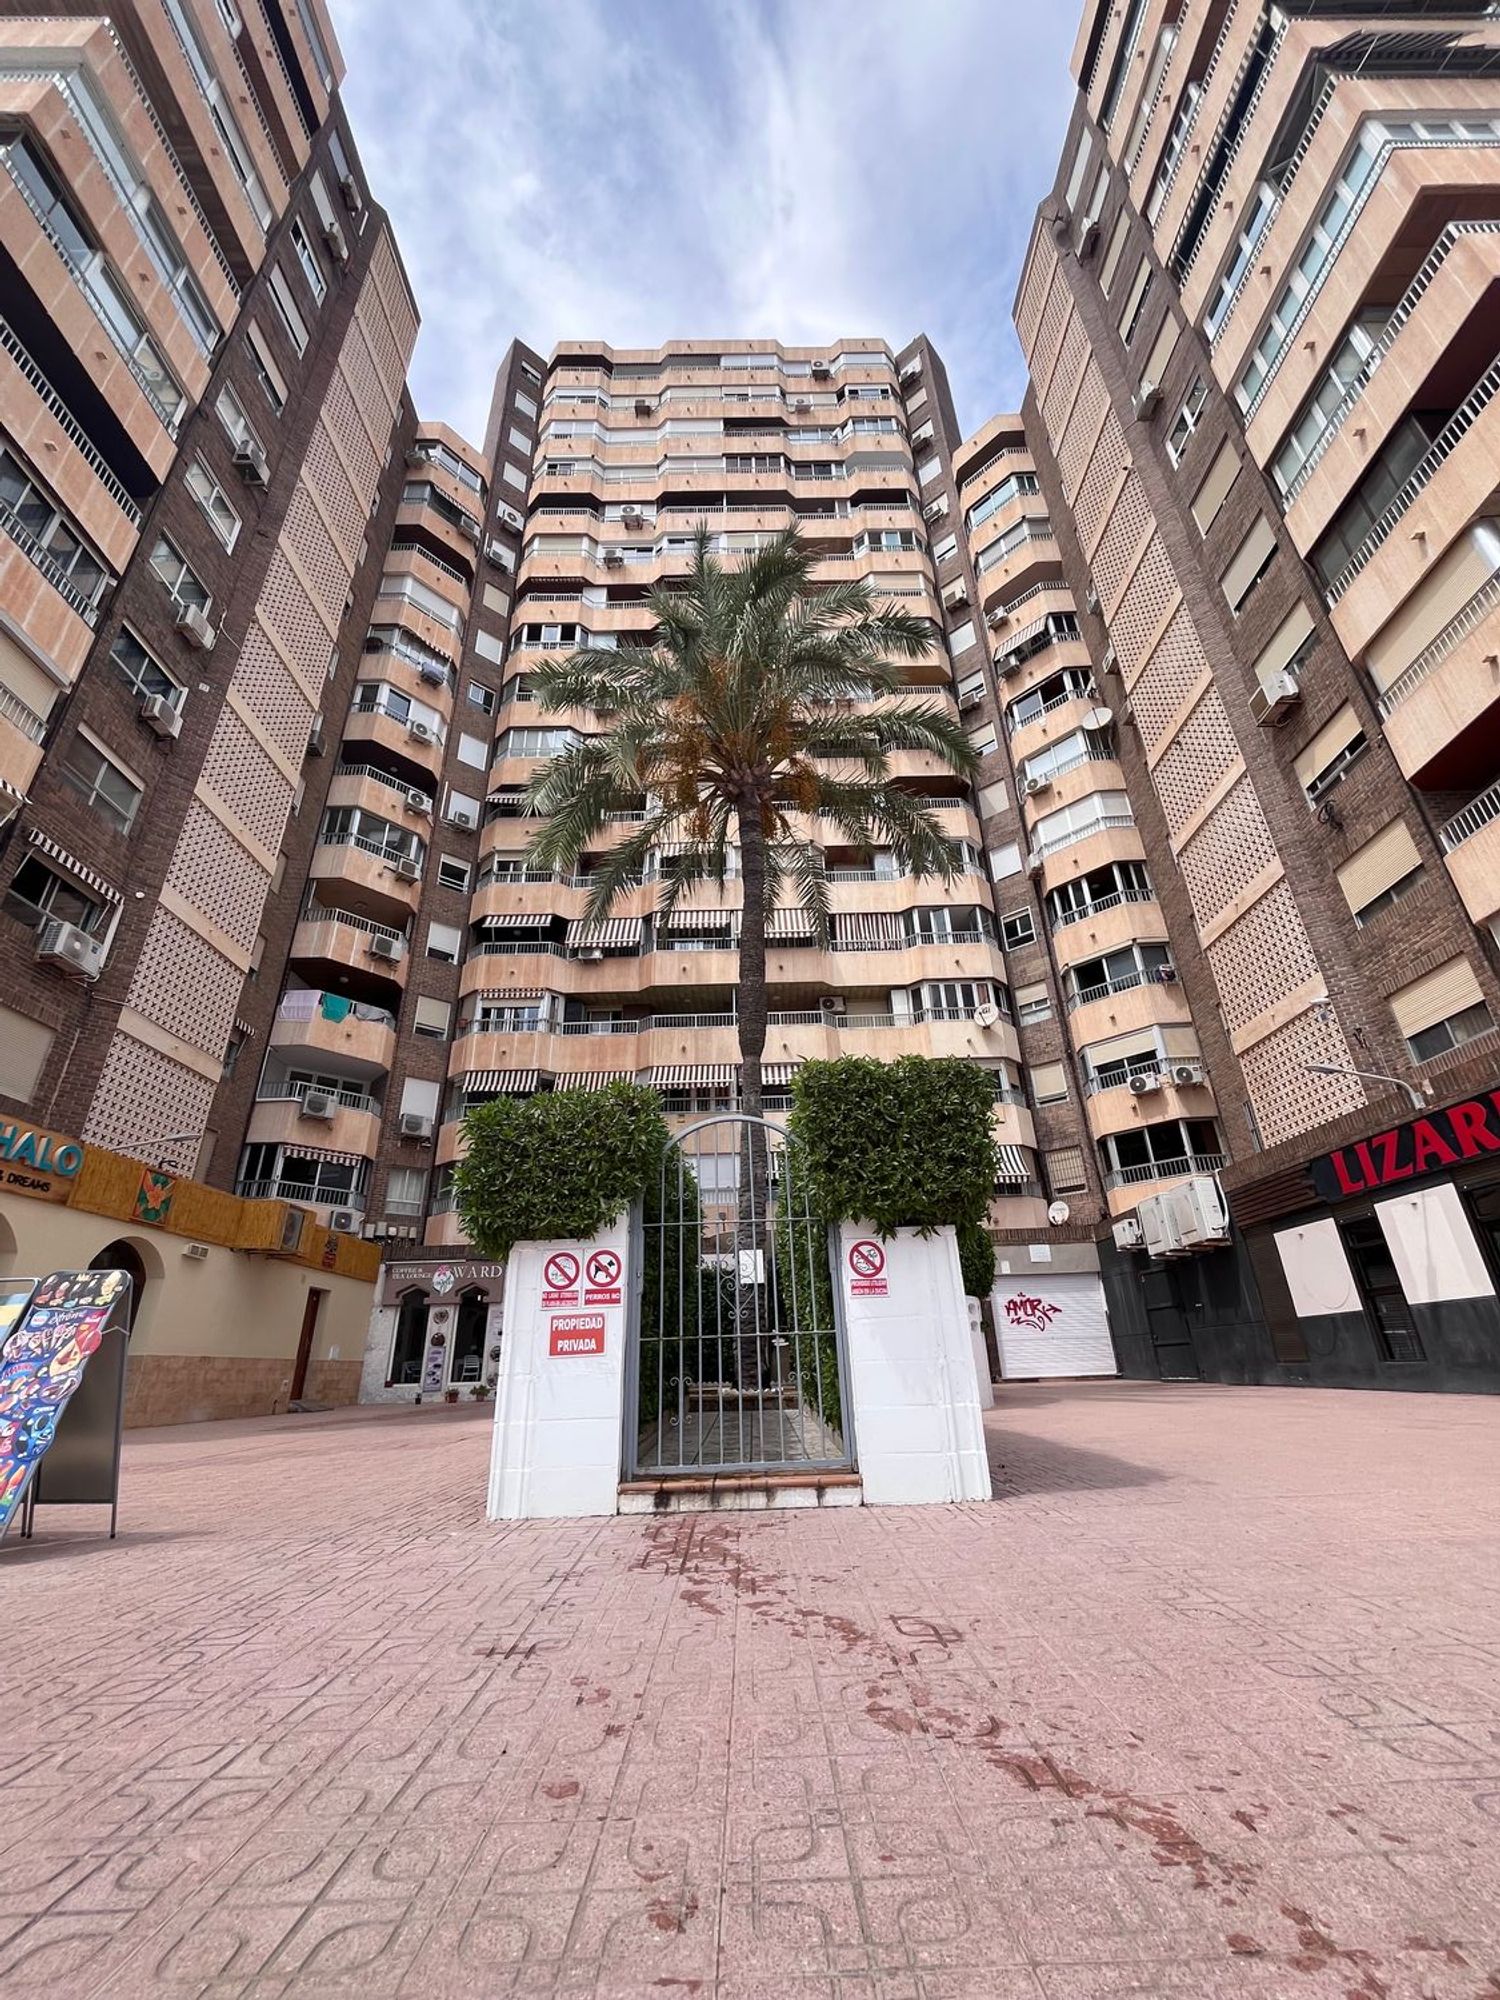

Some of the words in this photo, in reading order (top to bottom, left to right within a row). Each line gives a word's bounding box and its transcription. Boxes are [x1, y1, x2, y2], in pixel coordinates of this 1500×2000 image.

[6, 1172, 52, 1193] DREAMS
[452, 1264, 503, 1279] WARD
[585, 1293, 610, 1301] PERROS
[552, 1317, 603, 1331] PROPIEDAD
[557, 1338, 597, 1352] PRIVADA
